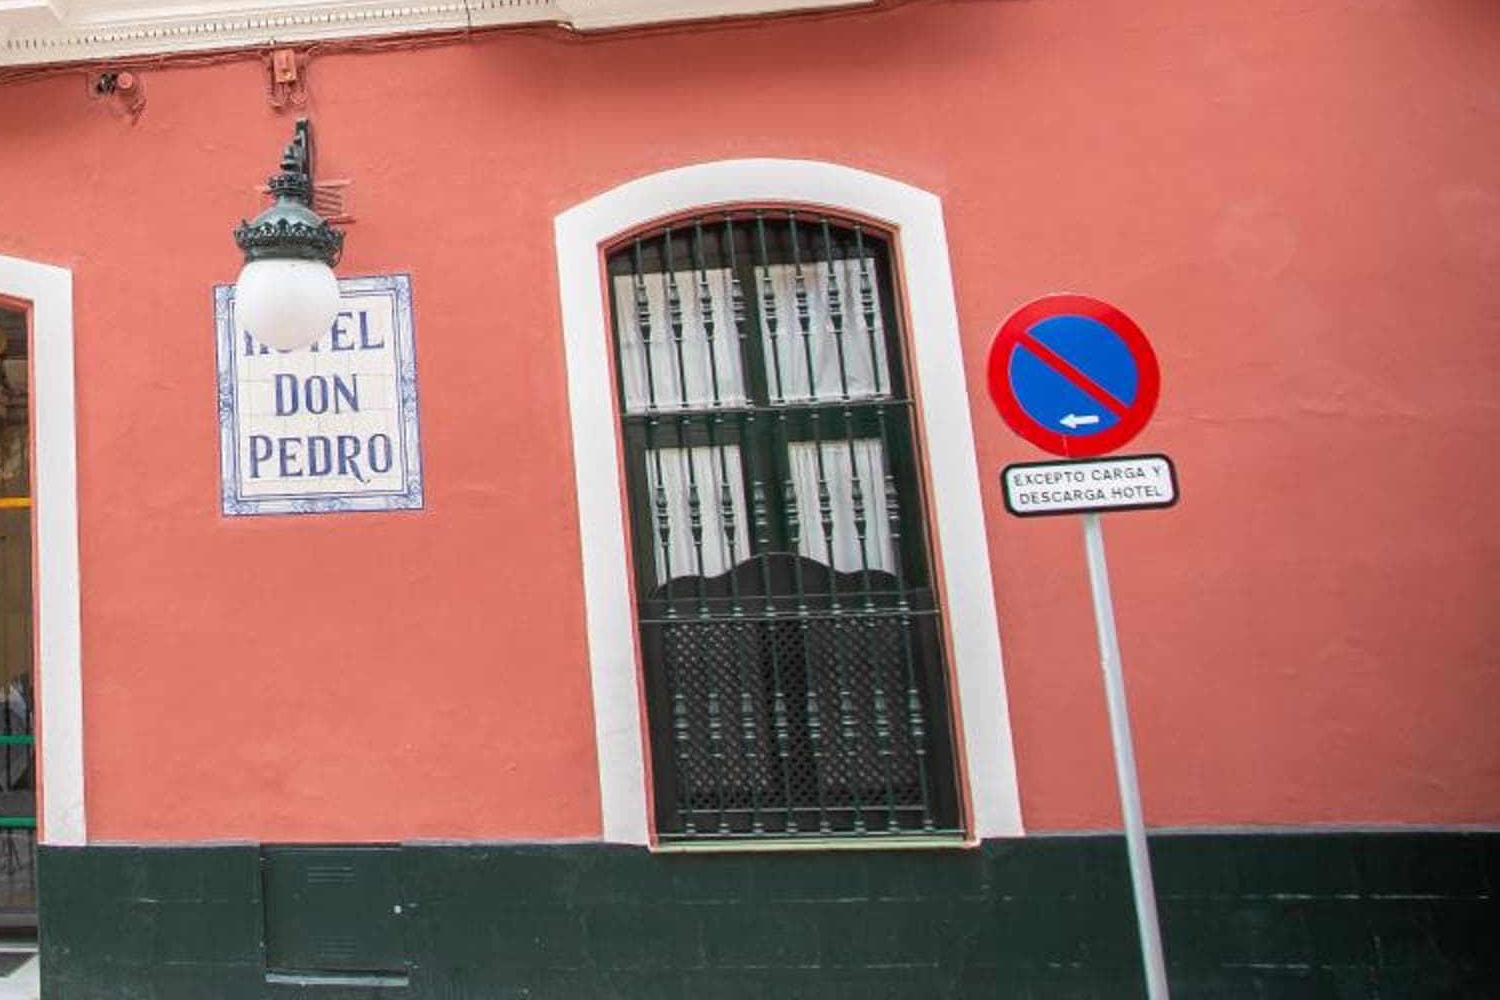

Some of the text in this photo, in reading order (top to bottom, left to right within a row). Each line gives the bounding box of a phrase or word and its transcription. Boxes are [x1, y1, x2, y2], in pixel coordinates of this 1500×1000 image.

[274, 373, 360, 416] DON
[249, 433, 393, 483] PEDRO
[1013, 466, 1162, 486] EXCEPTO CARGA Y
[1019, 484, 1163, 505] DESCARGA HOTEL
